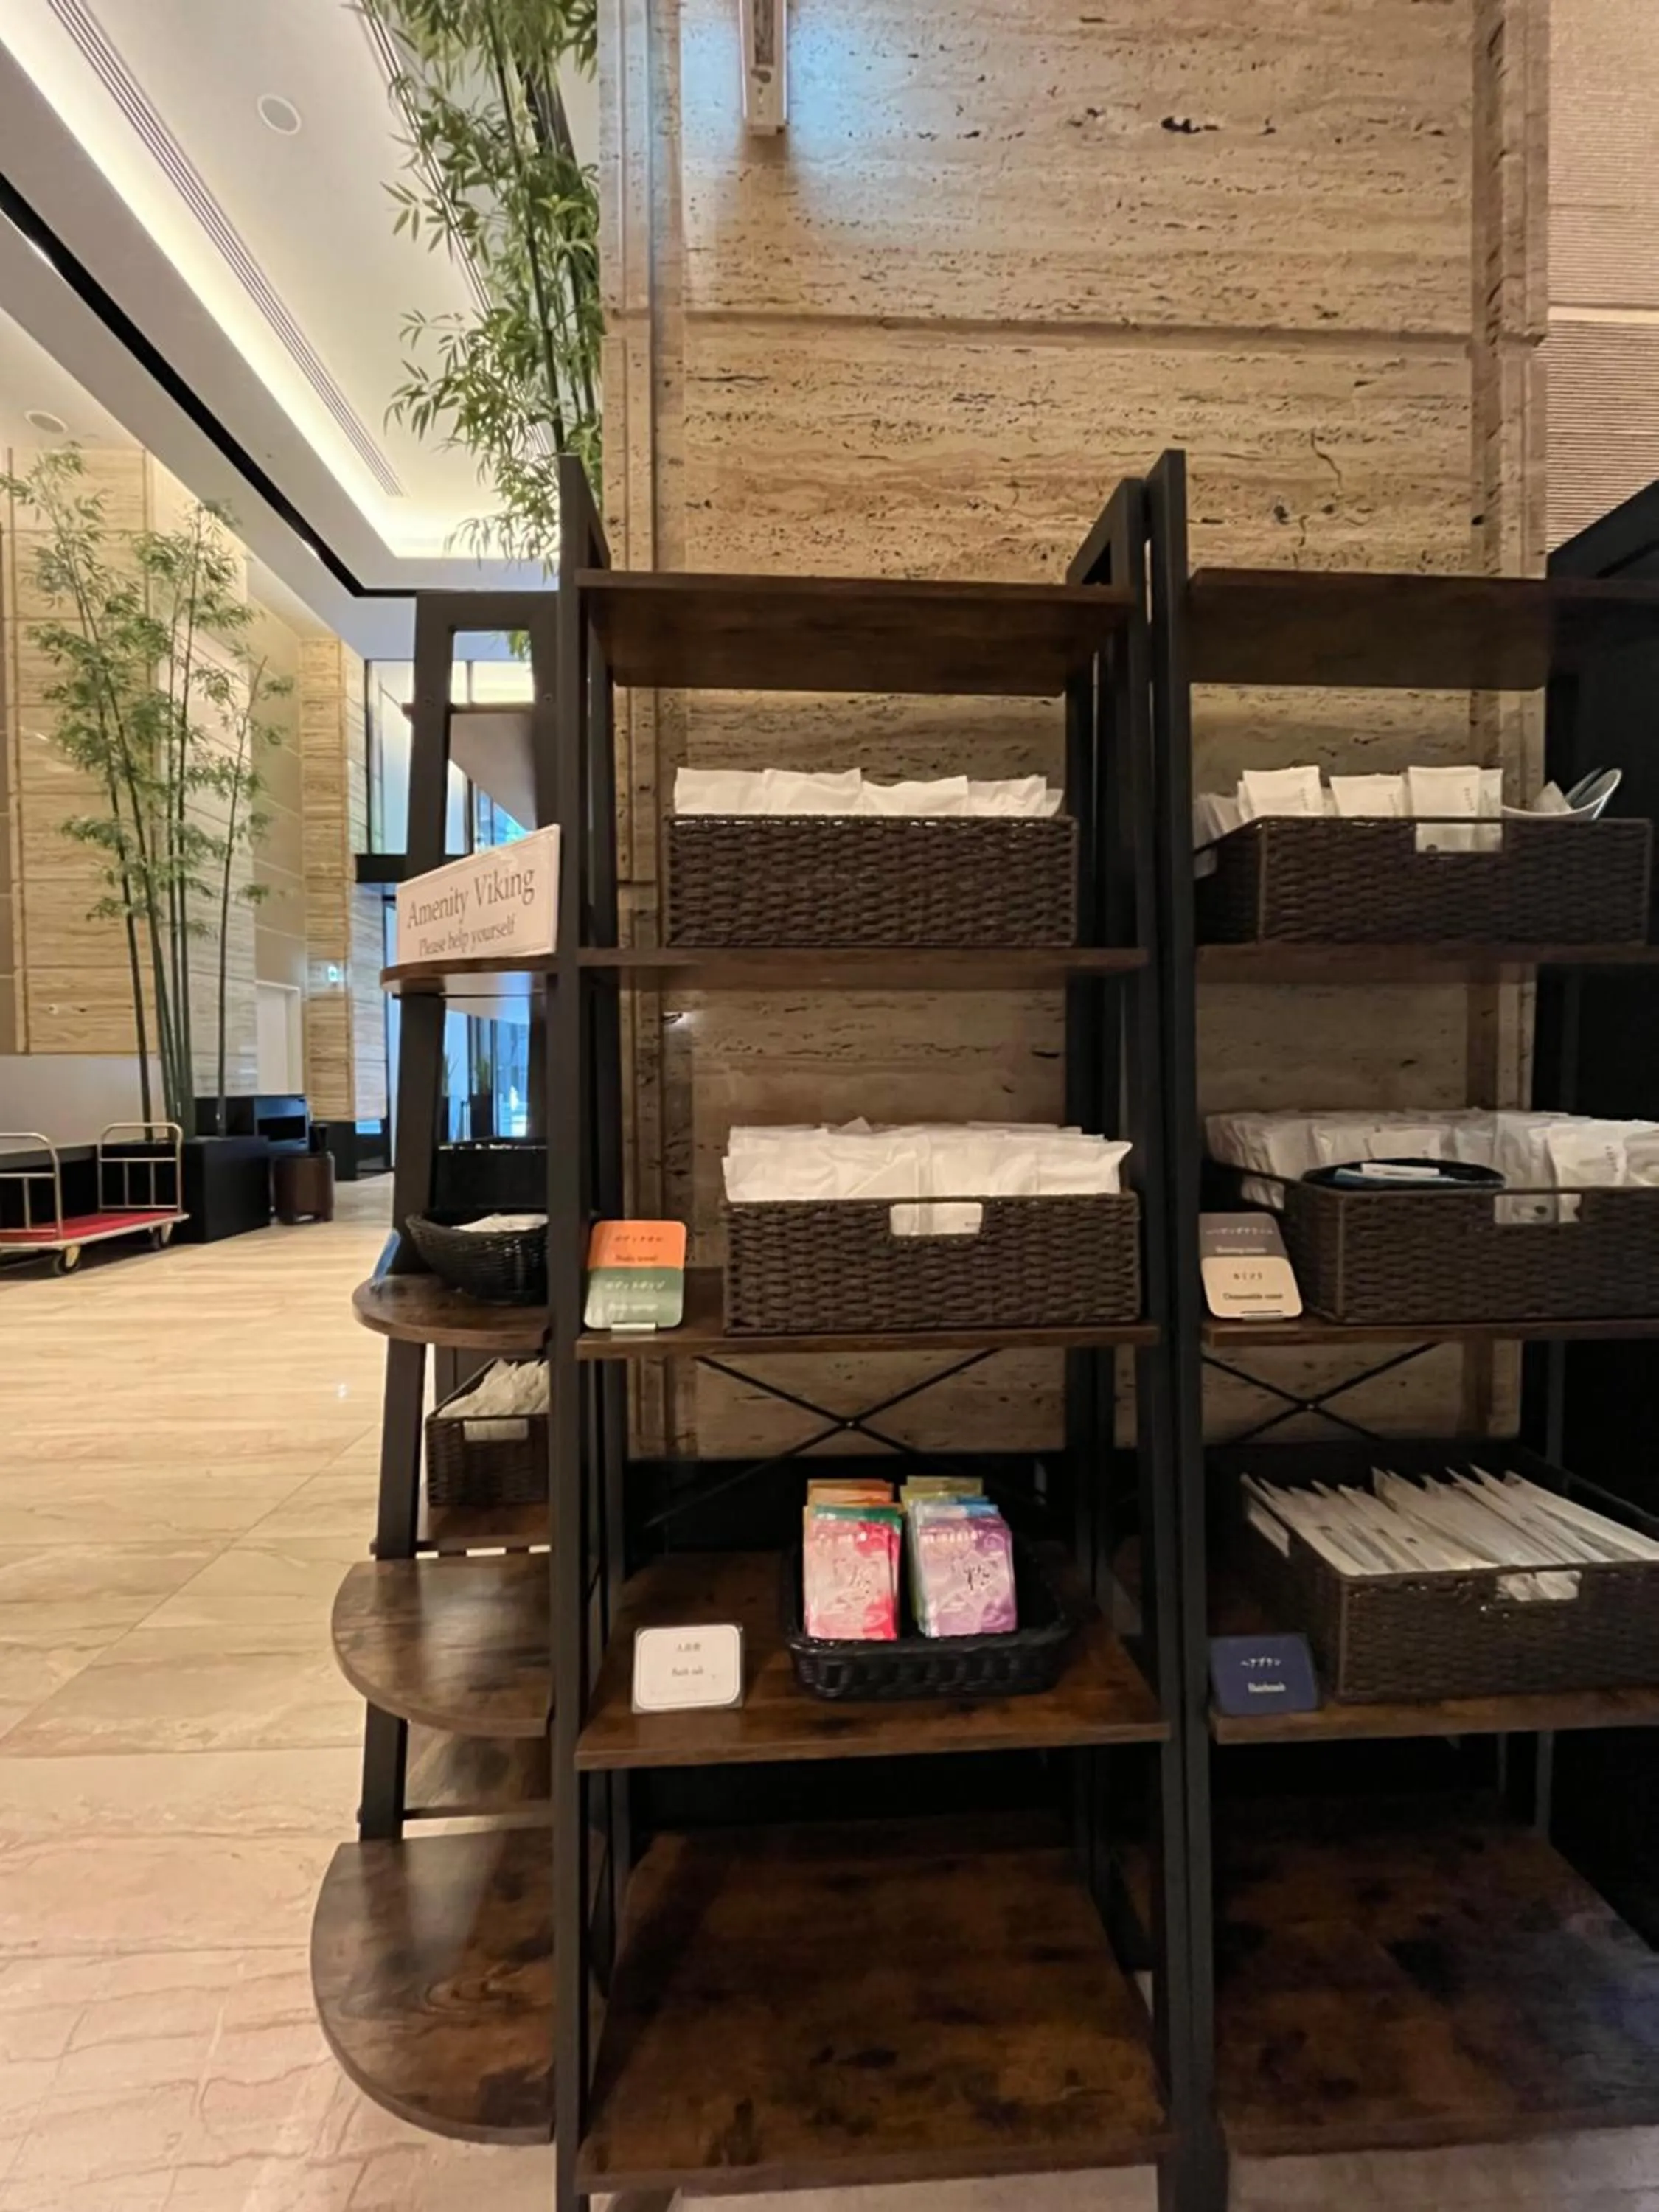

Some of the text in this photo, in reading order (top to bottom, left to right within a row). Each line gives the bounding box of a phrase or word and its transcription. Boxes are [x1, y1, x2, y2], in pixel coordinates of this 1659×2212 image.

[407, 868, 535, 929] Amenity Viking
[419, 912, 516, 957] Please help yourself
